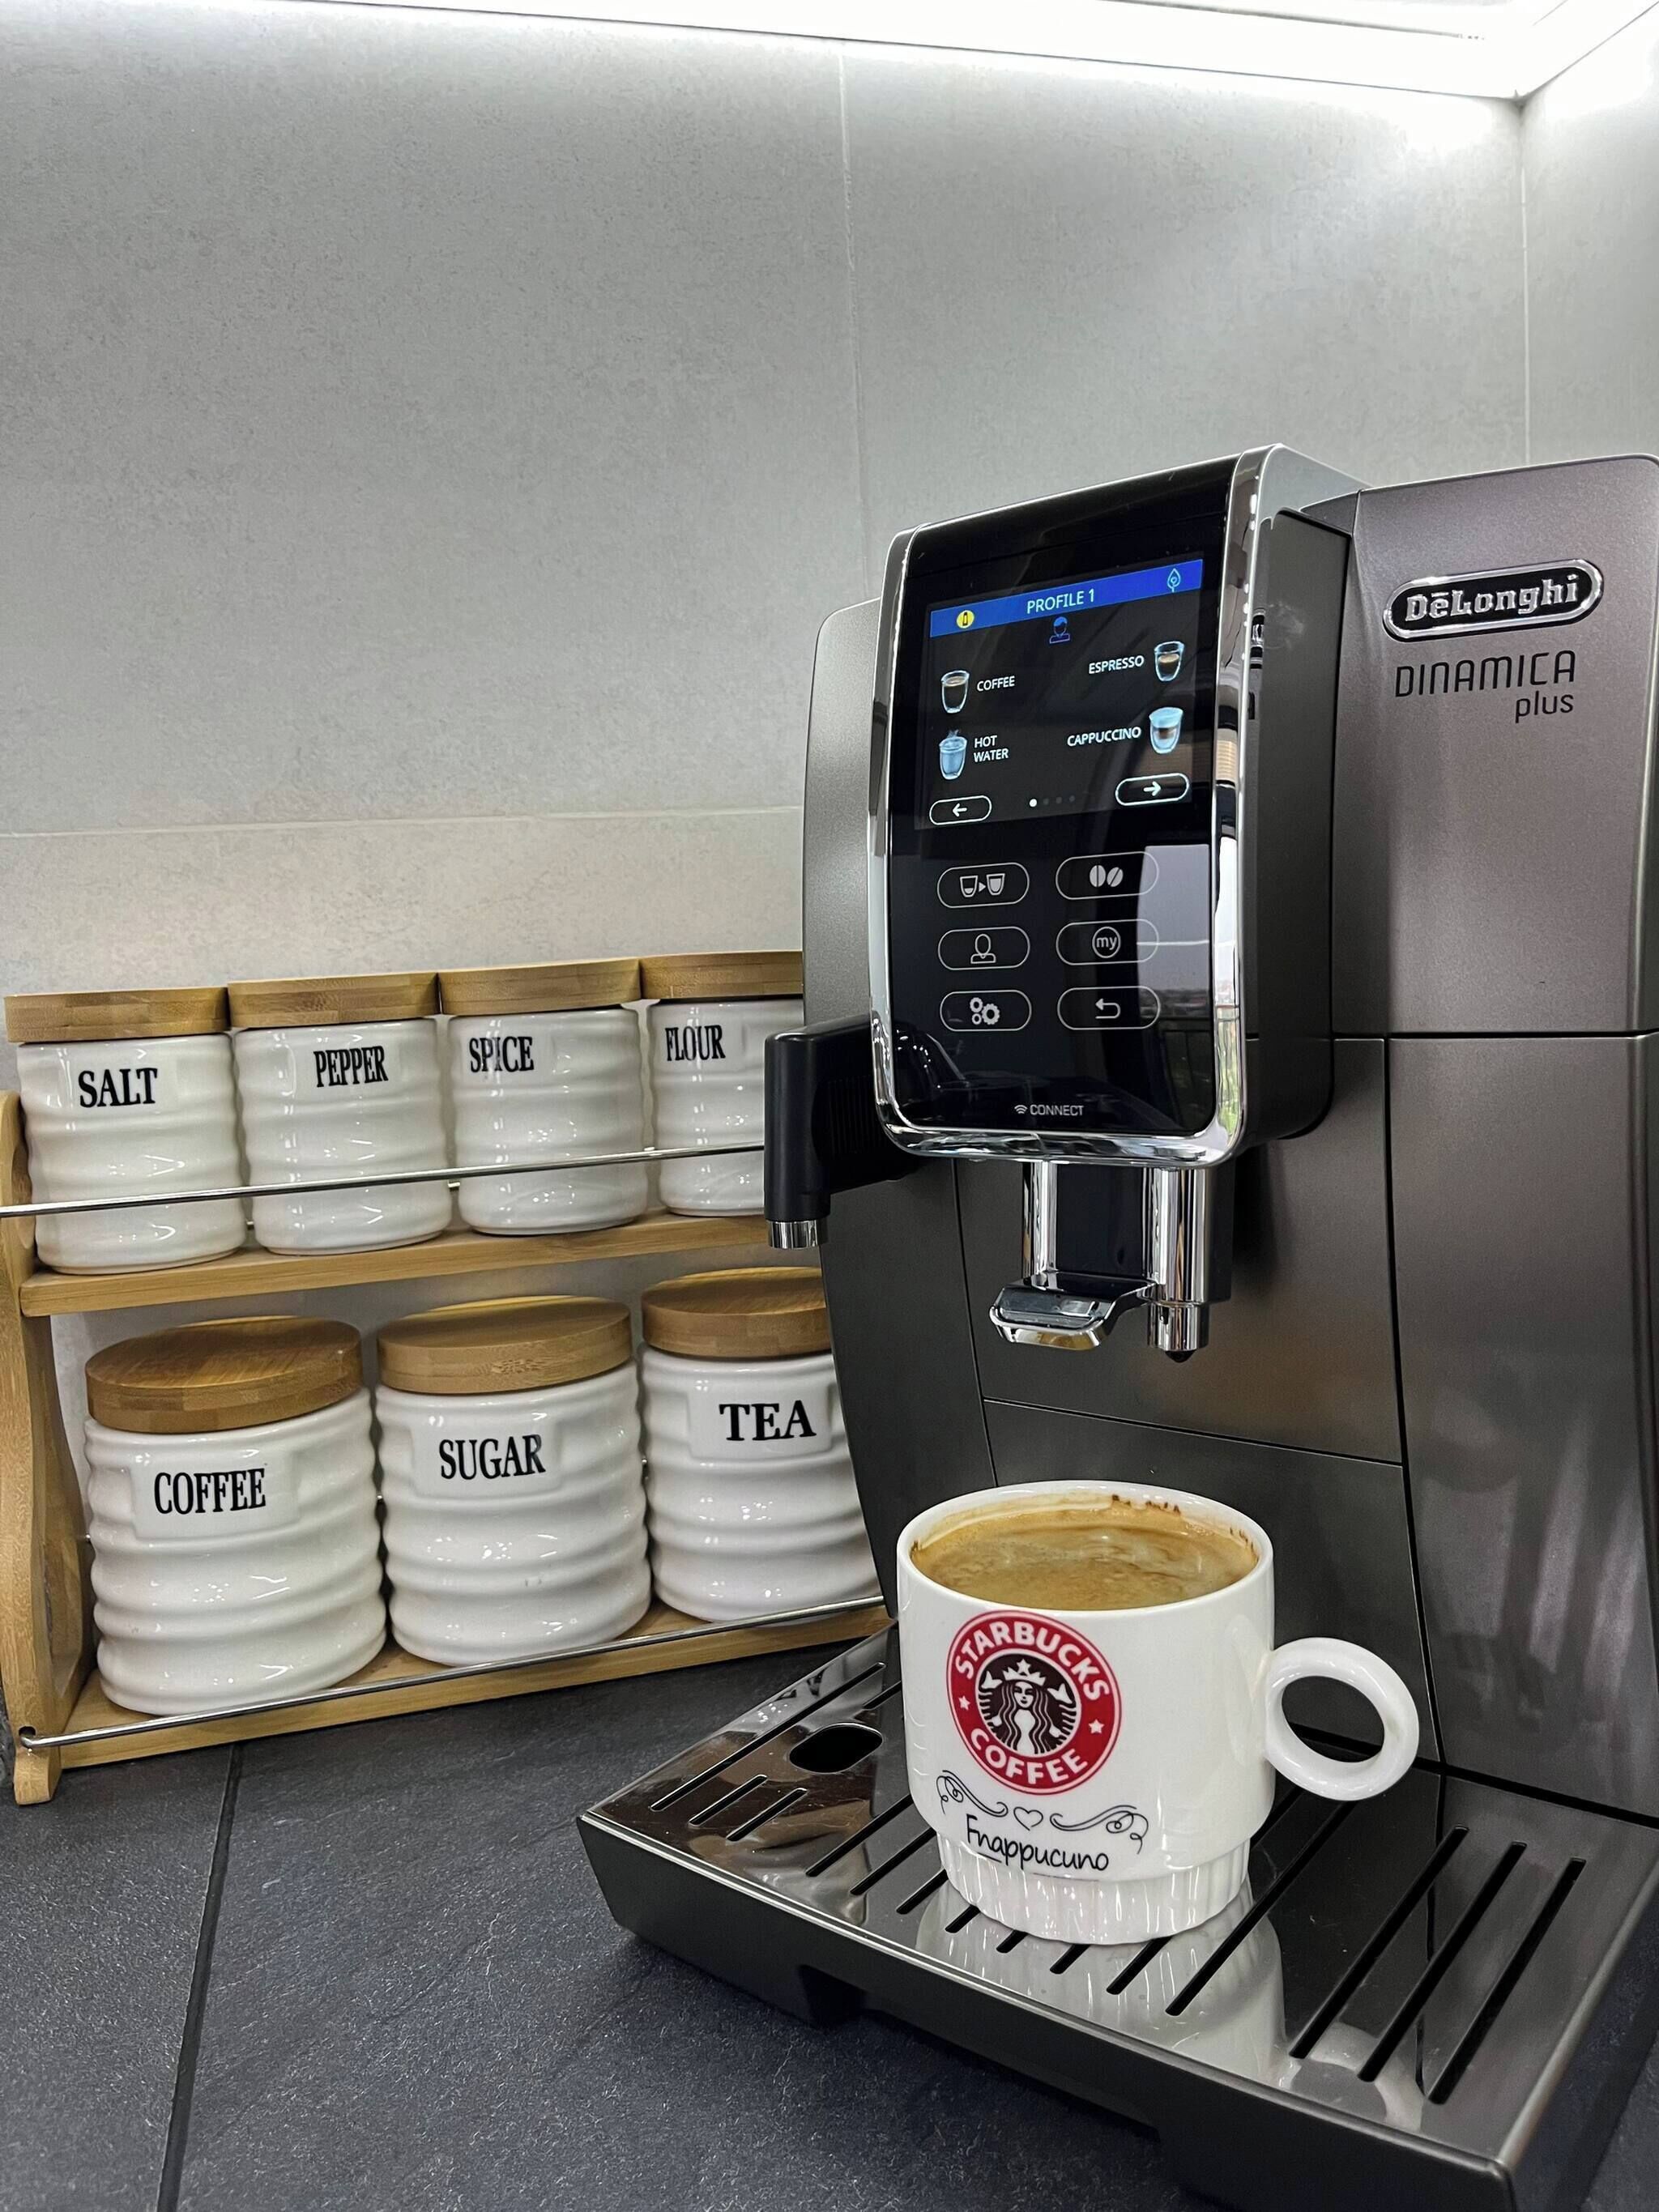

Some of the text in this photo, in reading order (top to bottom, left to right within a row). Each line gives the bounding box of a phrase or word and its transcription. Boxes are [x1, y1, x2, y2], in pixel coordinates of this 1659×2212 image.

[1026, 589, 1095, 614] PROFILE 1
[1088, 655, 1145, 675] ESPRESSO
[1395, 650, 1576, 697] DINAMICA
[976, 676, 1016, 693] COFFEE
[1515, 691, 1575, 724] plus
[974, 735, 997, 748] HOT
[1067, 726, 1141, 747] CAPPUCCINO
[973, 748, 1009, 763] WATER
[1096, 936, 1117, 951] my
[468, 1036, 535, 1073] SPICE
[665, 1025, 726, 1062] FLOUR
[313, 1046, 389, 1088] PEPPER
[78, 1068, 158, 1108] SALT
[1030, 1104, 1084, 1116] CONNECT
[719, 1400, 817, 1441] TEA
[438, 1434, 545, 1480] SUGAR
[154, 1468, 266, 1515] COFFEE
[955, 1621, 1110, 1701] STARBUCKS
[970, 1728, 1088, 1784] COFFEE
